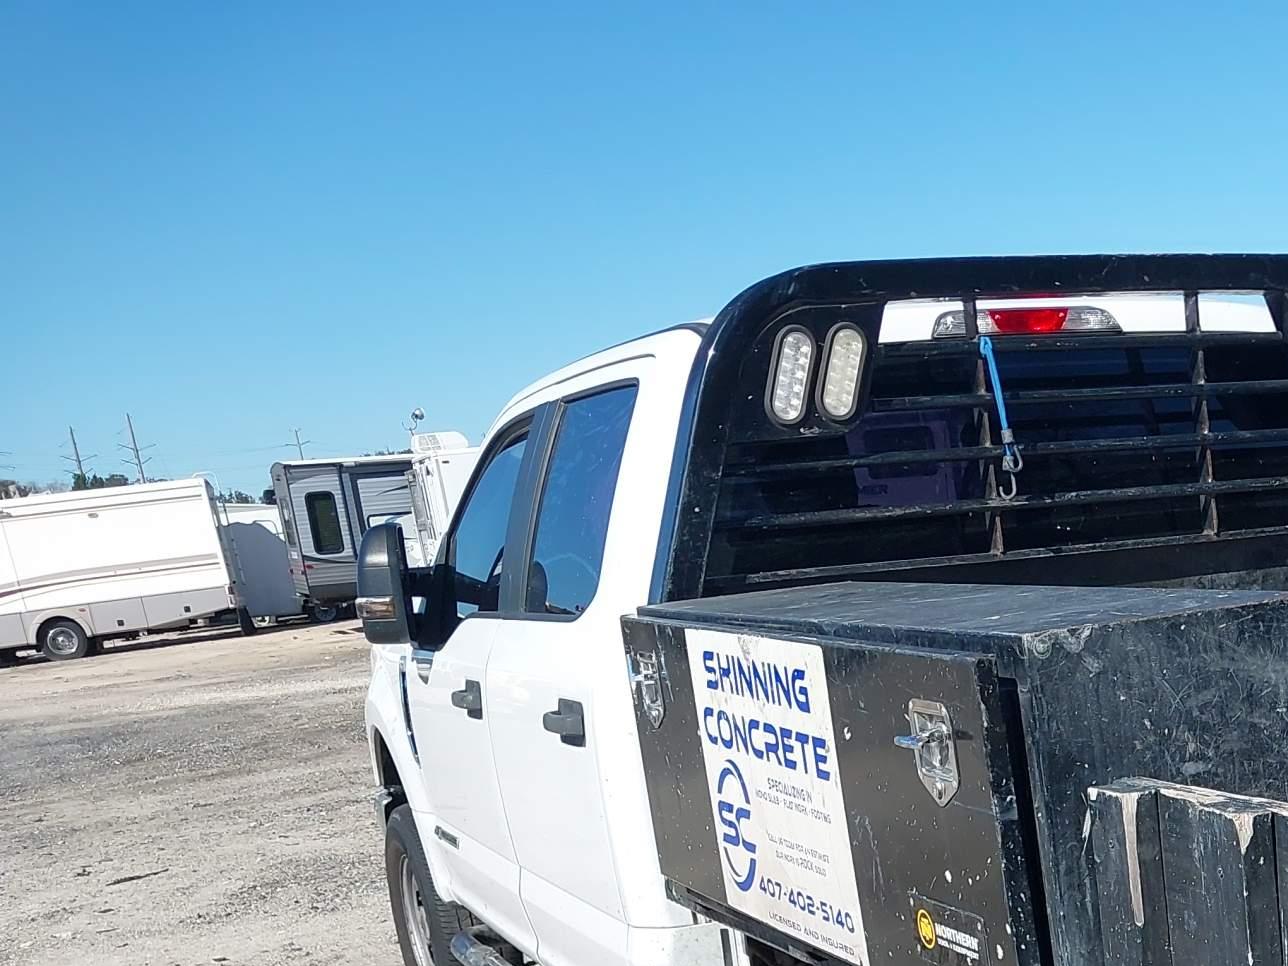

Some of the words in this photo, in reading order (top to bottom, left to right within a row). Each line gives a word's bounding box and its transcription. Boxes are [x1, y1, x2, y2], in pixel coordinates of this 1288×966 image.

[703, 706, 831, 781] CONCRETE
[718, 800, 757, 854] SC
[760, 875, 855, 934] 407-402-5140
[769, 911, 802, 931] LICENSED
[803, 924, 820, 940] AND
[935, 922, 979, 952] NORTHERN
